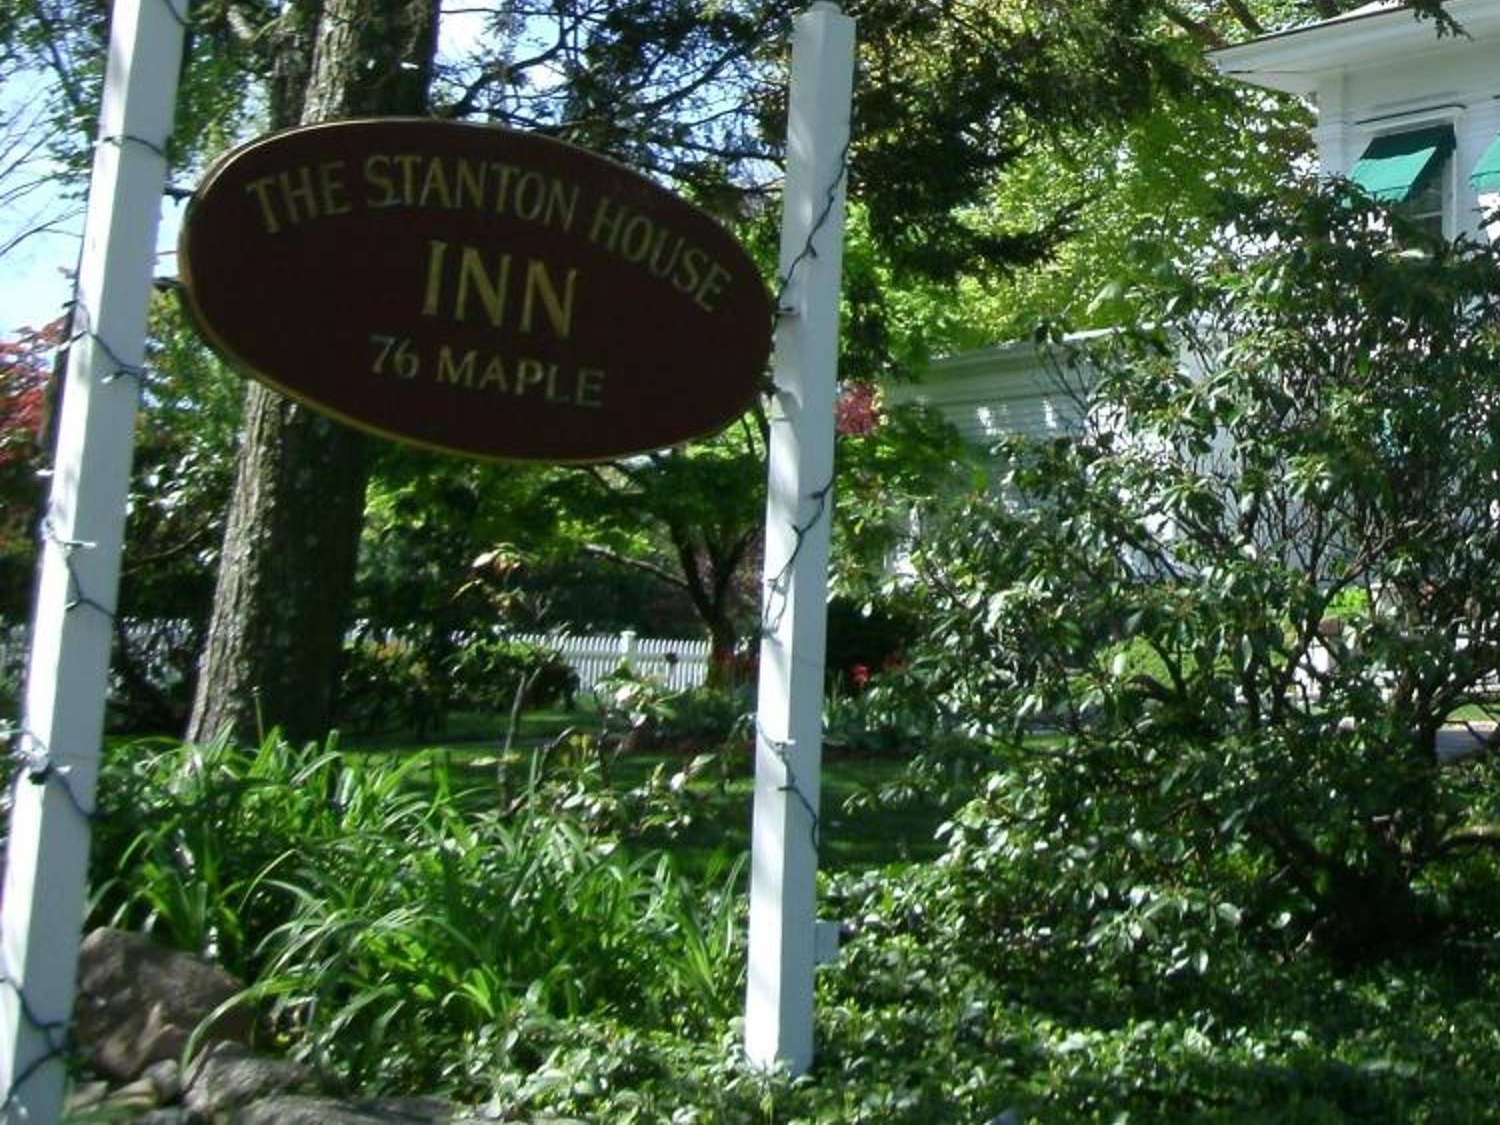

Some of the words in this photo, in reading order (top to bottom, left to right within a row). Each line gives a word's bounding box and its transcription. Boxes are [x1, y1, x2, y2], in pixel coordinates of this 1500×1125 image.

[246, 161, 352, 234] THE
[364, 154, 581, 234] STANTON
[588, 198, 731, 313] HOUSE
[421, 240, 578, 340] INN
[369, 334, 418, 379] 76
[436, 347, 606, 408] MAPLE
